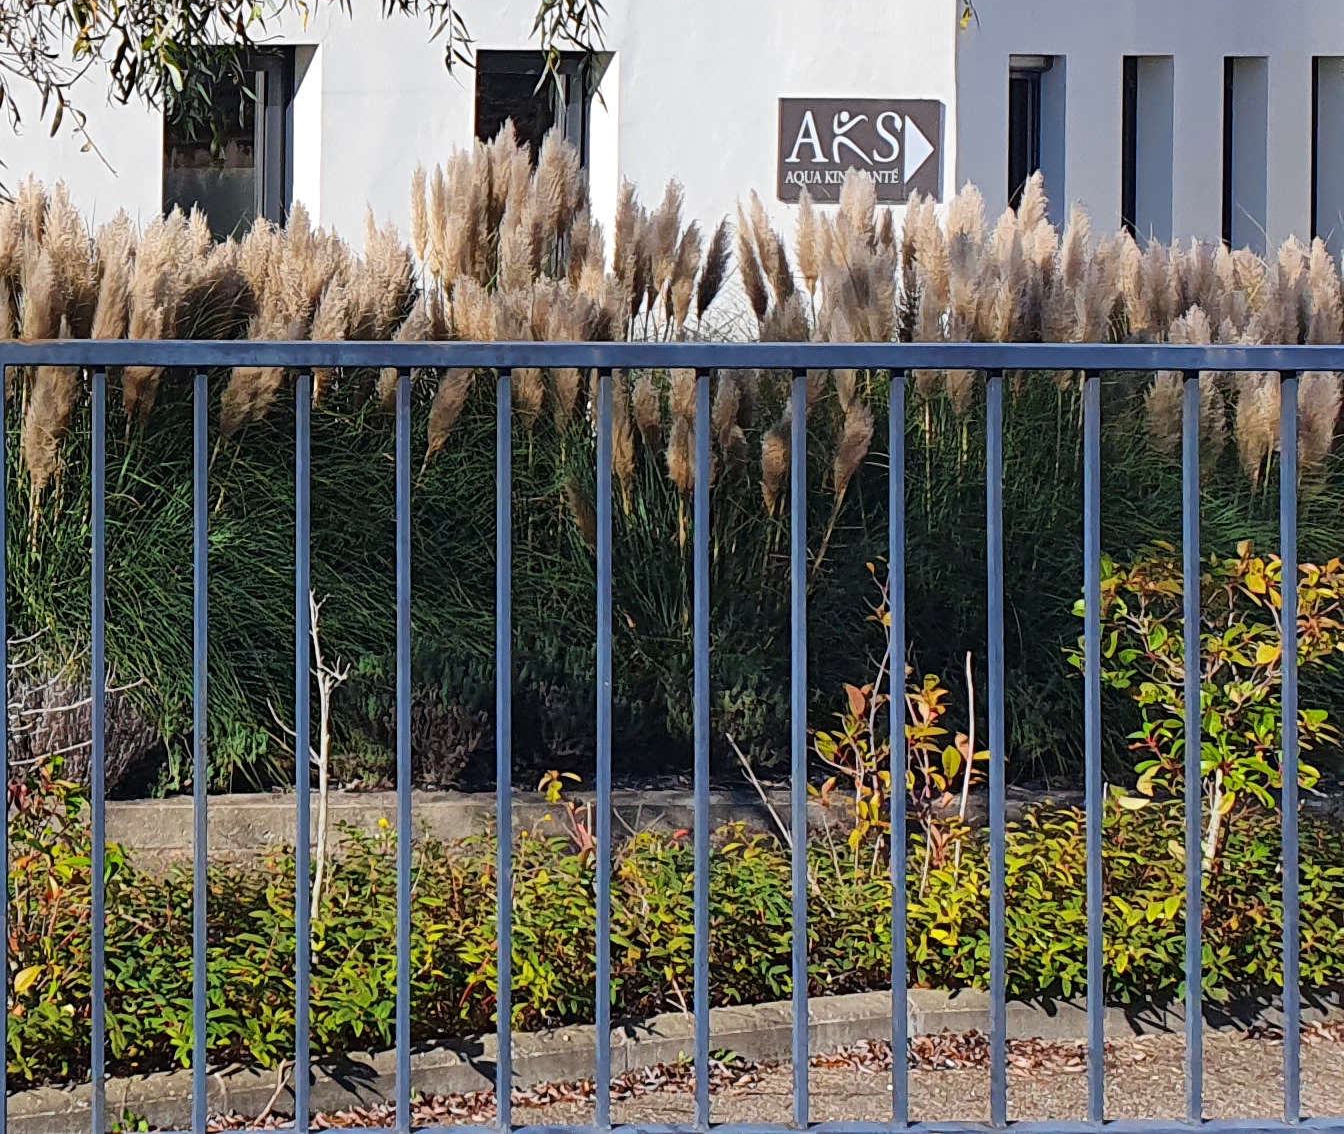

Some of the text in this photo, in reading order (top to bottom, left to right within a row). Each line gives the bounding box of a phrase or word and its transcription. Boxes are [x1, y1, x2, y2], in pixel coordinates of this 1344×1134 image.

[785, 110, 902, 165] AKS
[785, 170, 822, 186] AQUA
[825, 170, 852, 184] KIN
